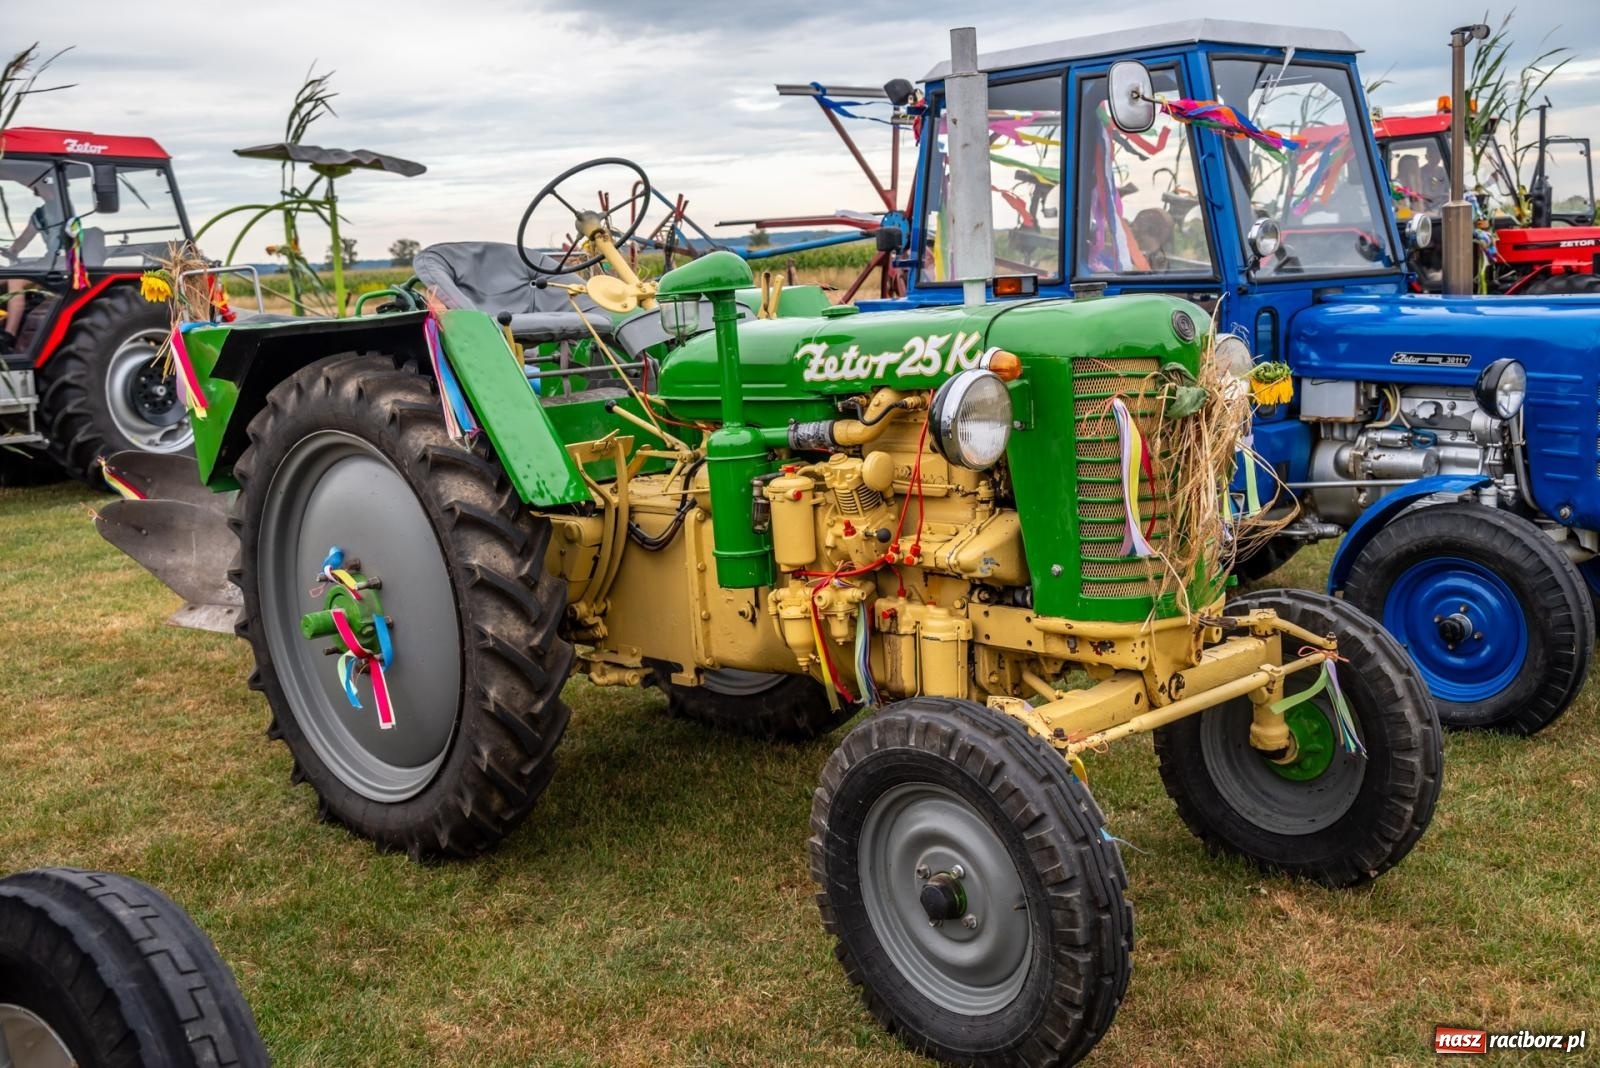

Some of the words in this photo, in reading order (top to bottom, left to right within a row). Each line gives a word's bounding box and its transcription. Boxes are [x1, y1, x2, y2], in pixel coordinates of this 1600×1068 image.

[63, 138, 109, 155] Zetor
[1559, 239, 1596, 248] ZETOR
[795, 341, 904, 382] Zetor
